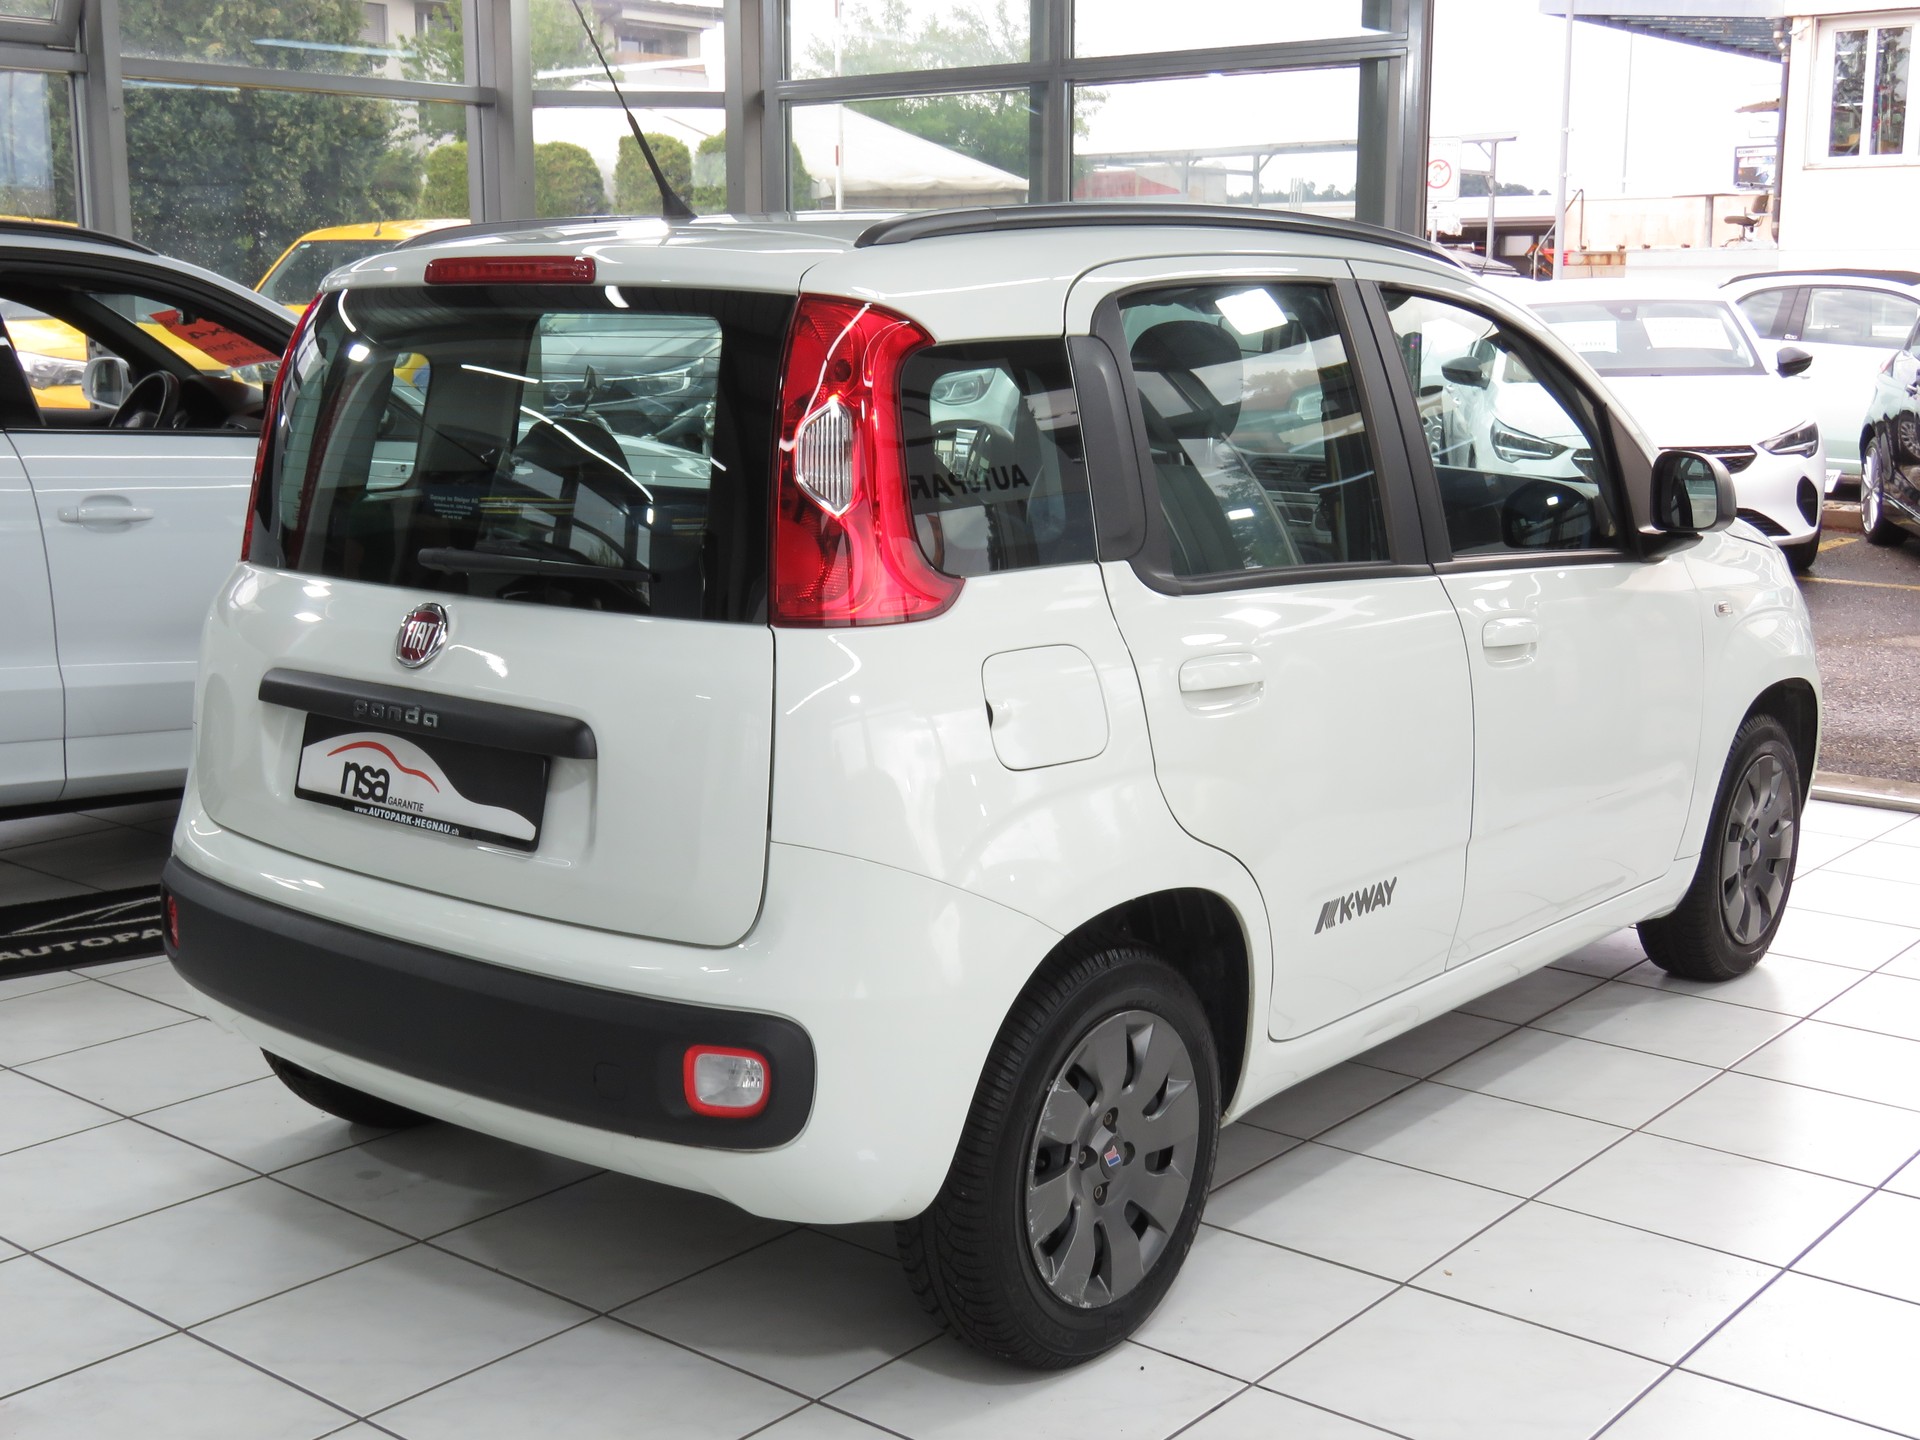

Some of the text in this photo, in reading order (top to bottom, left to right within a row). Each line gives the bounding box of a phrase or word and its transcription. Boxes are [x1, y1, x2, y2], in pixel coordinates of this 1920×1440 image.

[403, 620, 437, 651] FIAT
[353, 699, 440, 729] panda
[340, 761, 390, 804] nsa
[387, 796, 424, 813] GARANTIE
[353, 805, 460, 837] www.AUTOPARK-HEGNAU.ch
